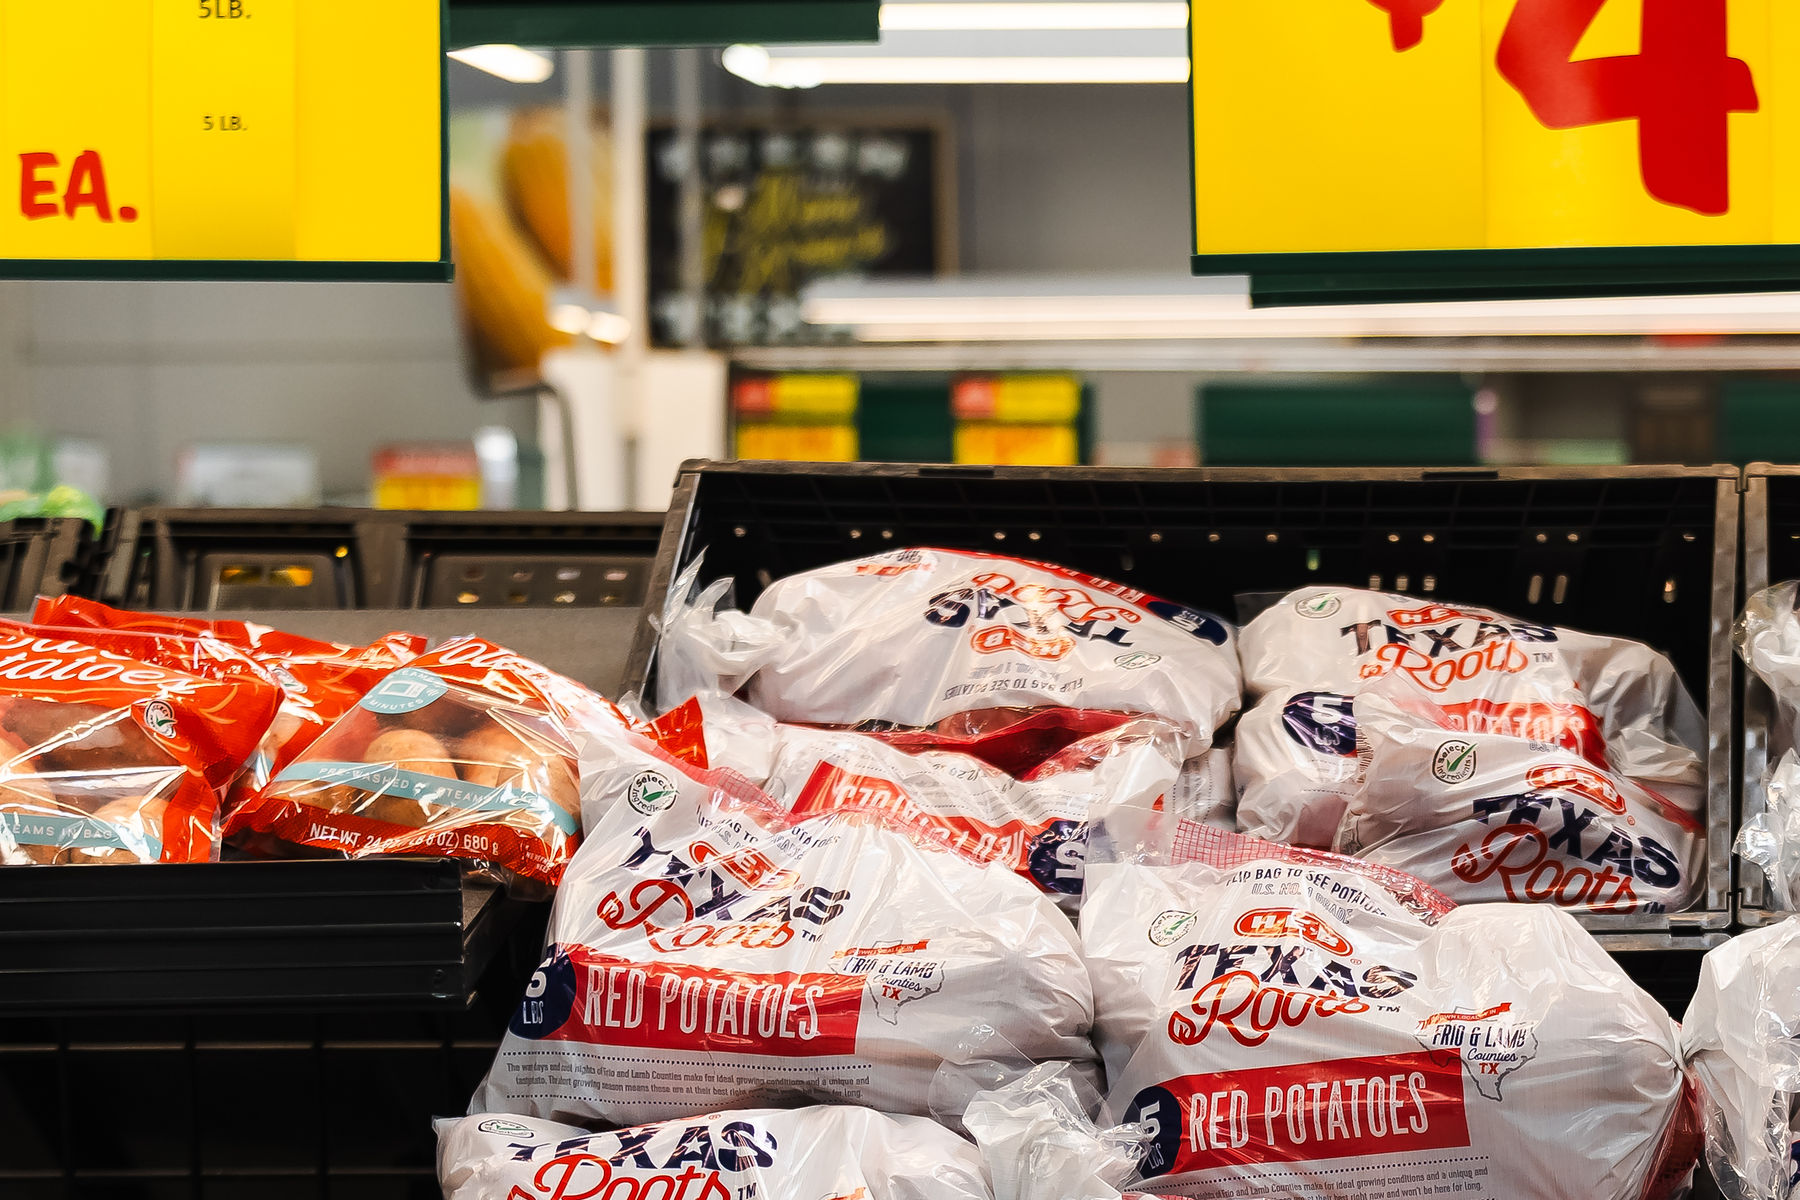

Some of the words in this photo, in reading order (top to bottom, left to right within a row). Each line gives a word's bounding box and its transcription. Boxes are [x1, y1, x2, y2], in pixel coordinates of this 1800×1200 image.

[203, 116, 214, 130] 5
[220, 116, 247, 130] LB.
[1496, 0, 1759, 217] 4
[19, 149, 138, 223] EA.
[84, 829, 113, 838] BAG
[310, 822, 338, 840] NET
[340, 830, 363, 847] WT.
[464, 834, 488, 850] 680
[492, 842, 498, 854] g
[1472, 792, 1682, 888] TEXAS
[1305, 872, 1332, 892] SEE
[1450, 823, 1640, 915] Roots
[892, 959, 937, 979] LAMB
[1172, 942, 1416, 1001] TEXAS
[584, 964, 651, 1030] RED
[658, 969, 825, 1041] POTATOES
[881, 985, 902, 999] TX
[1168, 969, 1371, 1048] Roots
[1432, 1021, 1464, 1048] FRIO
[1483, 1019, 1527, 1051] LAMB
[1467, 1046, 1519, 1065] Counties
[1478, 1062, 1500, 1076] TX
[1139, 1102, 1161, 1137] 5
[1189, 1086, 1249, 1154] RED
[1264, 1070, 1429, 1148] POTATOES
[508, 1120, 779, 1172] TEXAS
[1250, 1184, 1270, 1195] Lamb
[1337, 1180, 1354, 1189] ideal
[1357, 1178, 1386, 1189] growing
[1388, 1174, 1425, 1185] conditions
[1427, 1172, 1440, 1180] and
[1474, 1167, 1488, 1176] and
[1387, 1189, 1400, 1198] and
[1402, 1187, 1422, 1197] won't
[1434, 1184, 1450, 1193] here
[1465, 1181, 1482, 1192] long.
